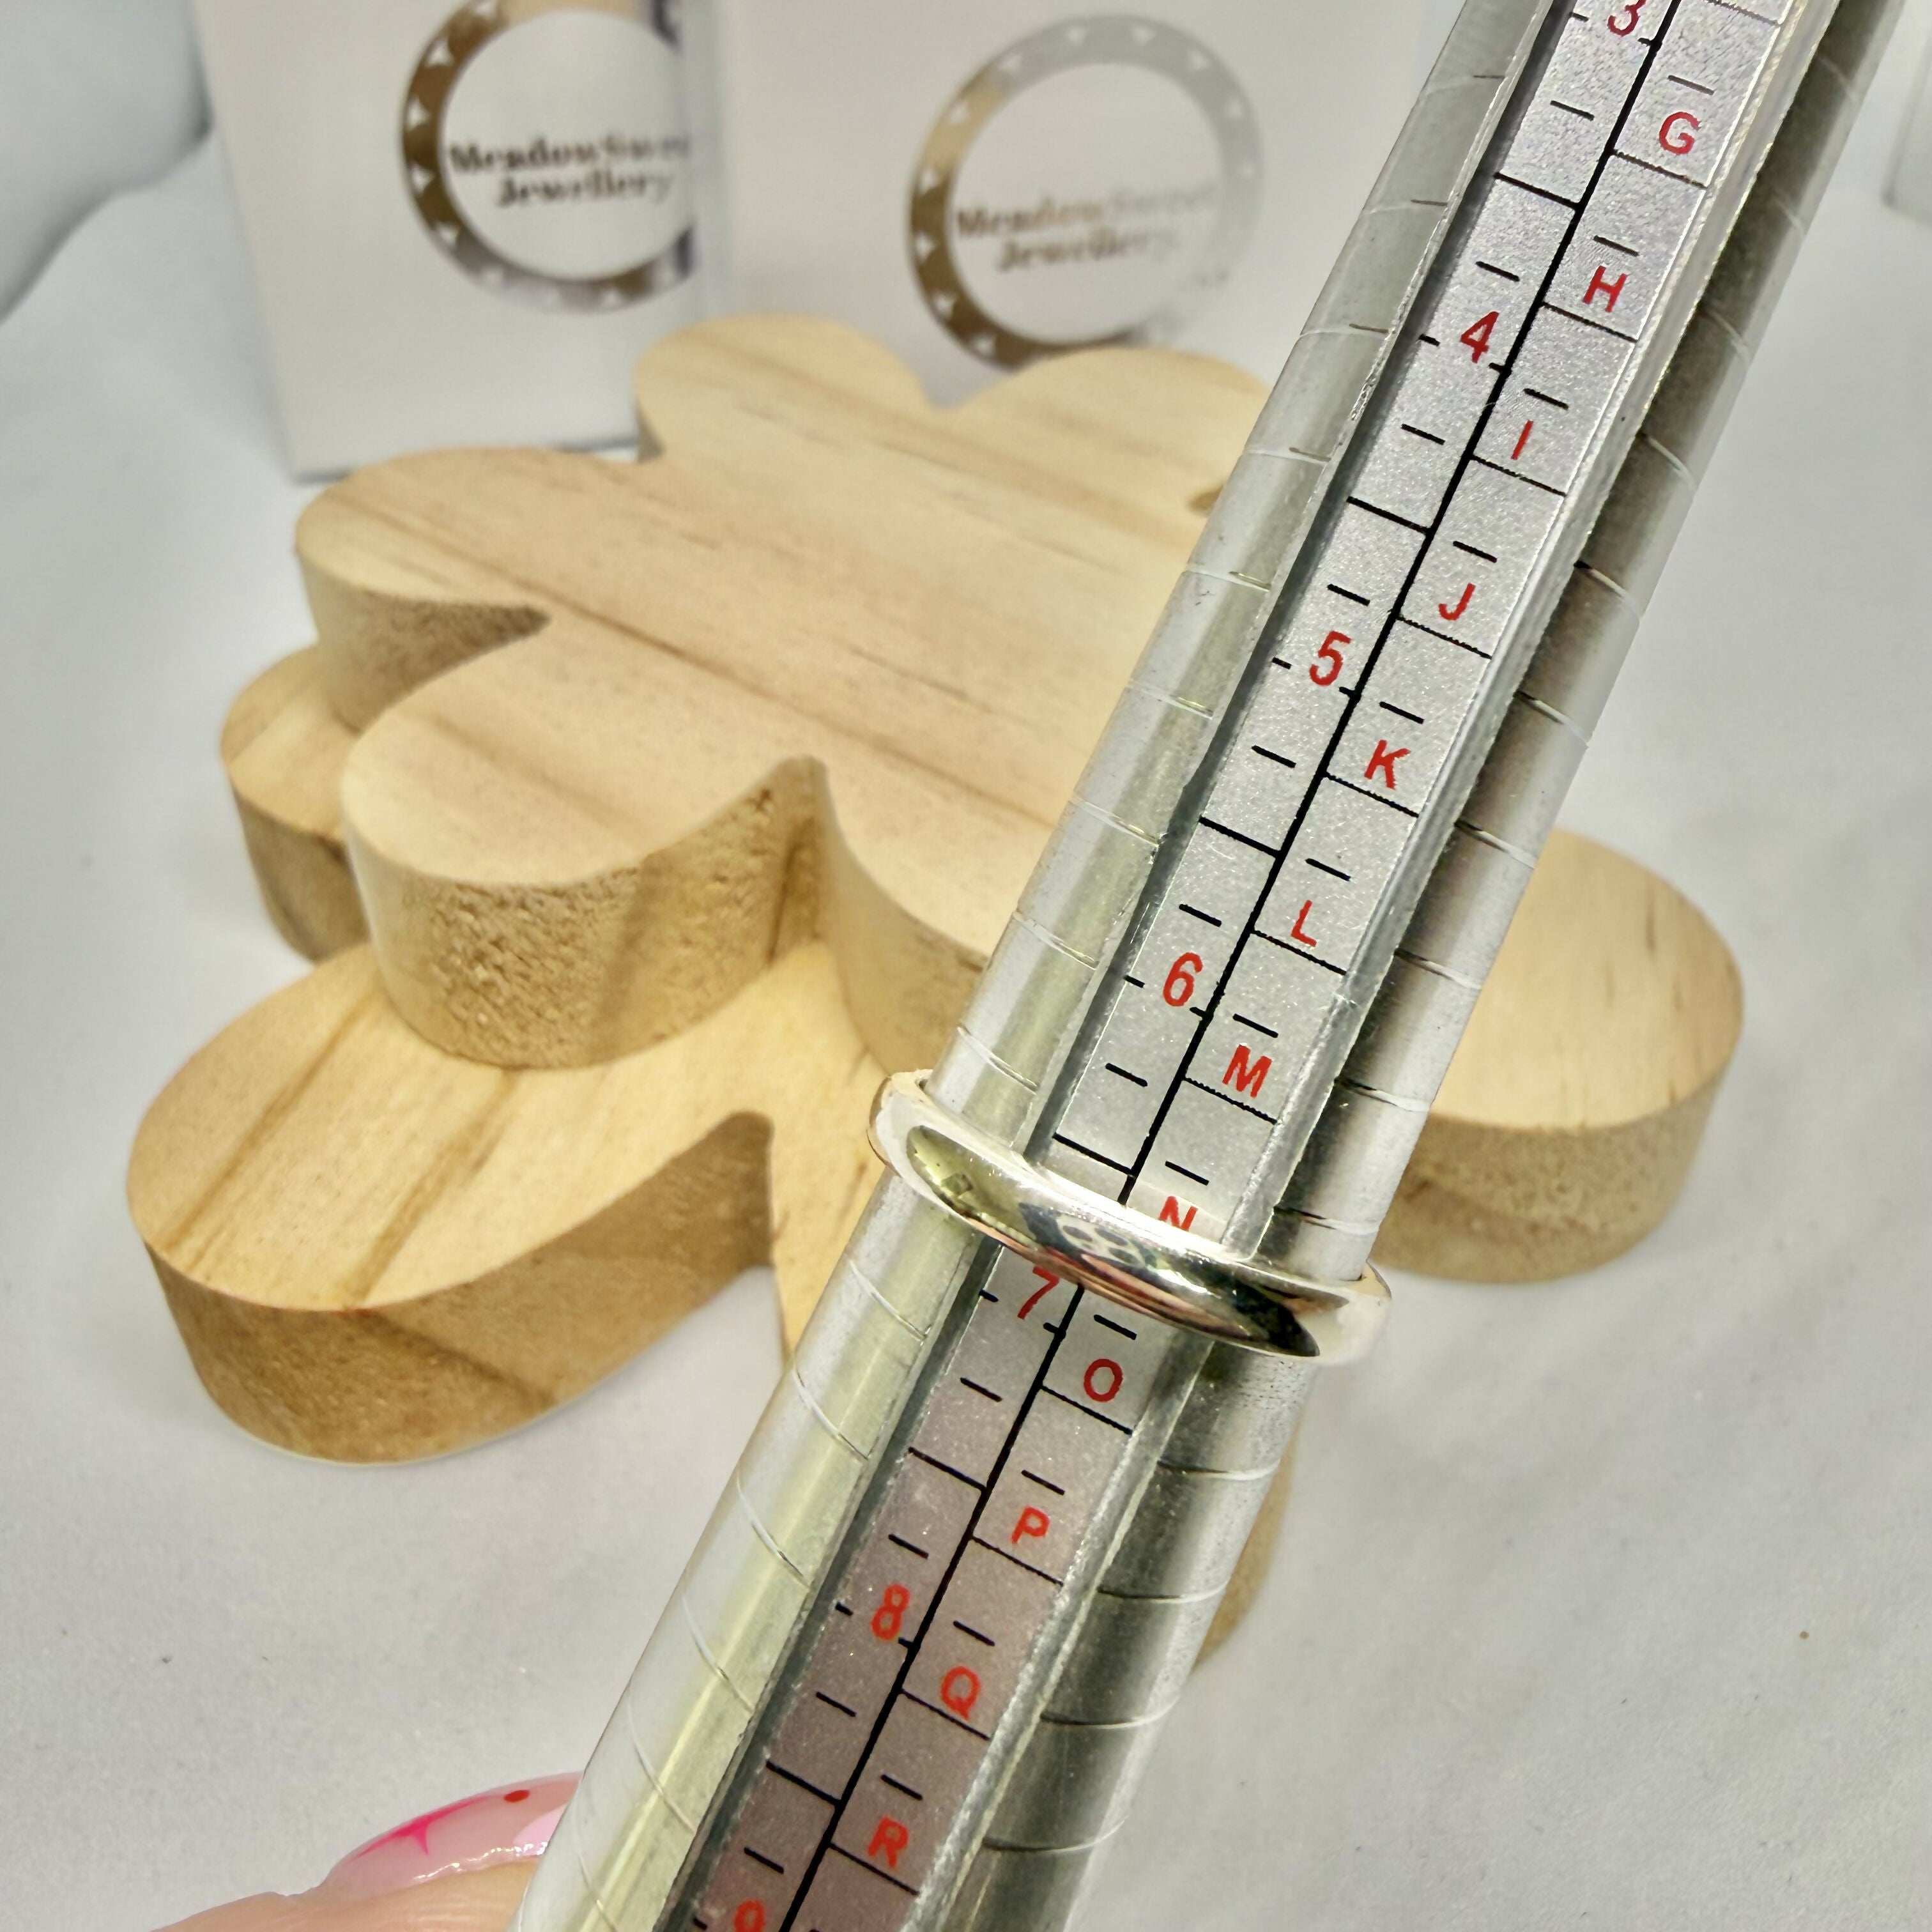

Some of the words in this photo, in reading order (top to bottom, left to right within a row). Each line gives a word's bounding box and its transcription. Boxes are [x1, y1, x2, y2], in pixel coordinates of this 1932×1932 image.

[1659, 112, 1699, 155] G
[498, 169, 672, 206] Jewellery
[1584, 266, 1627, 312] H
[1460, 312, 1498, 363] 4
[1512, 421, 1533, 461] I
[1438, 583, 1475, 621] J
[1309, 631, 1351, 687] 5
[1364, 739, 1410, 790] K
[1290, 900, 1317, 947] L
[1162, 952, 1204, 1007] 6
[1222, 1045, 1272, 1098] M
[1017, 1265, 1060, 1320] 7
[1083, 1358, 1124, 1402] O
[1009, 1505, 1051, 1545] P
[868, 1583, 912, 1642] 8
[939, 1665, 983, 1721] Q
[866, 1814, 910, 1871] R
